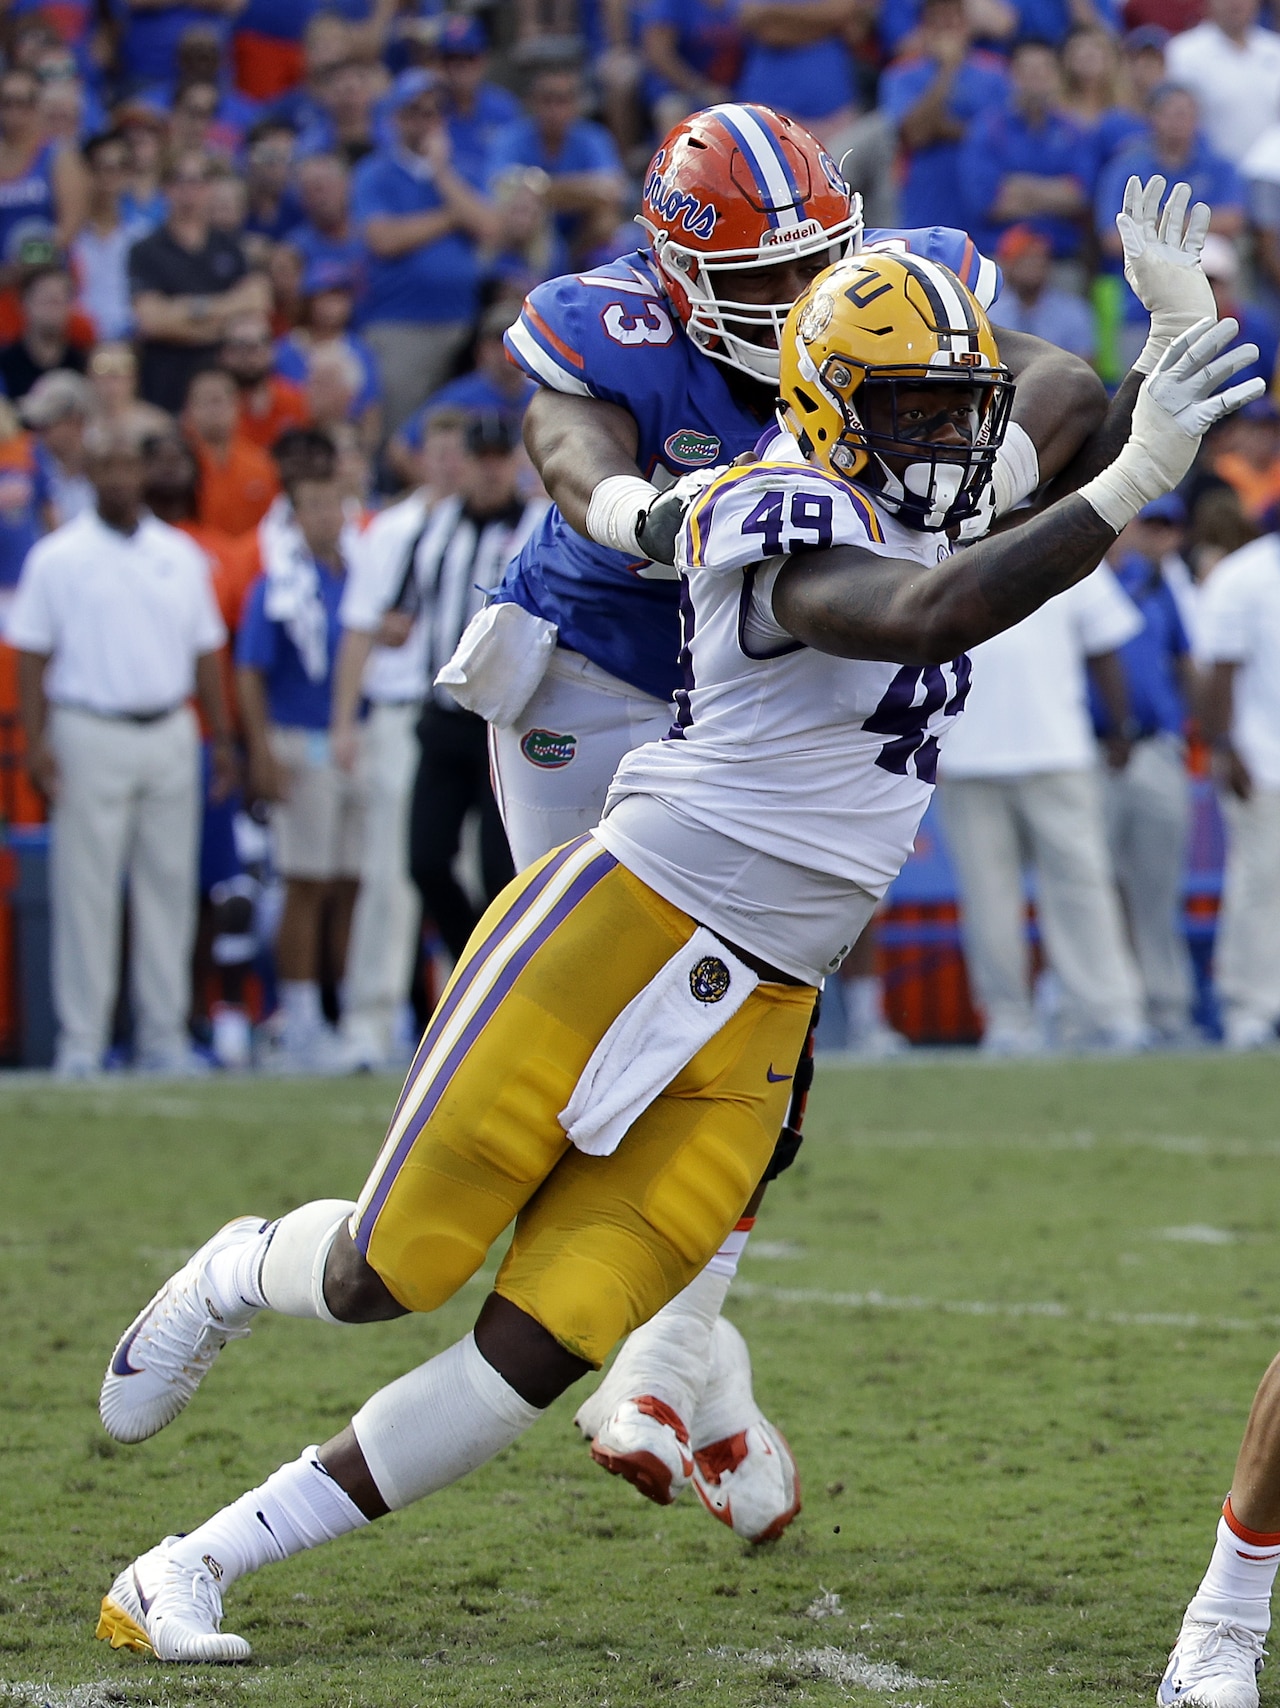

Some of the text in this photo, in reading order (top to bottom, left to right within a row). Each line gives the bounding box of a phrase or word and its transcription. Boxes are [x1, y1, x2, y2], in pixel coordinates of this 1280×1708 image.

[769, 223, 818, 246] Riddell
[576, 266, 676, 347] 73
[950, 352, 982, 367] LSU
[741, 491, 834, 556] 49
